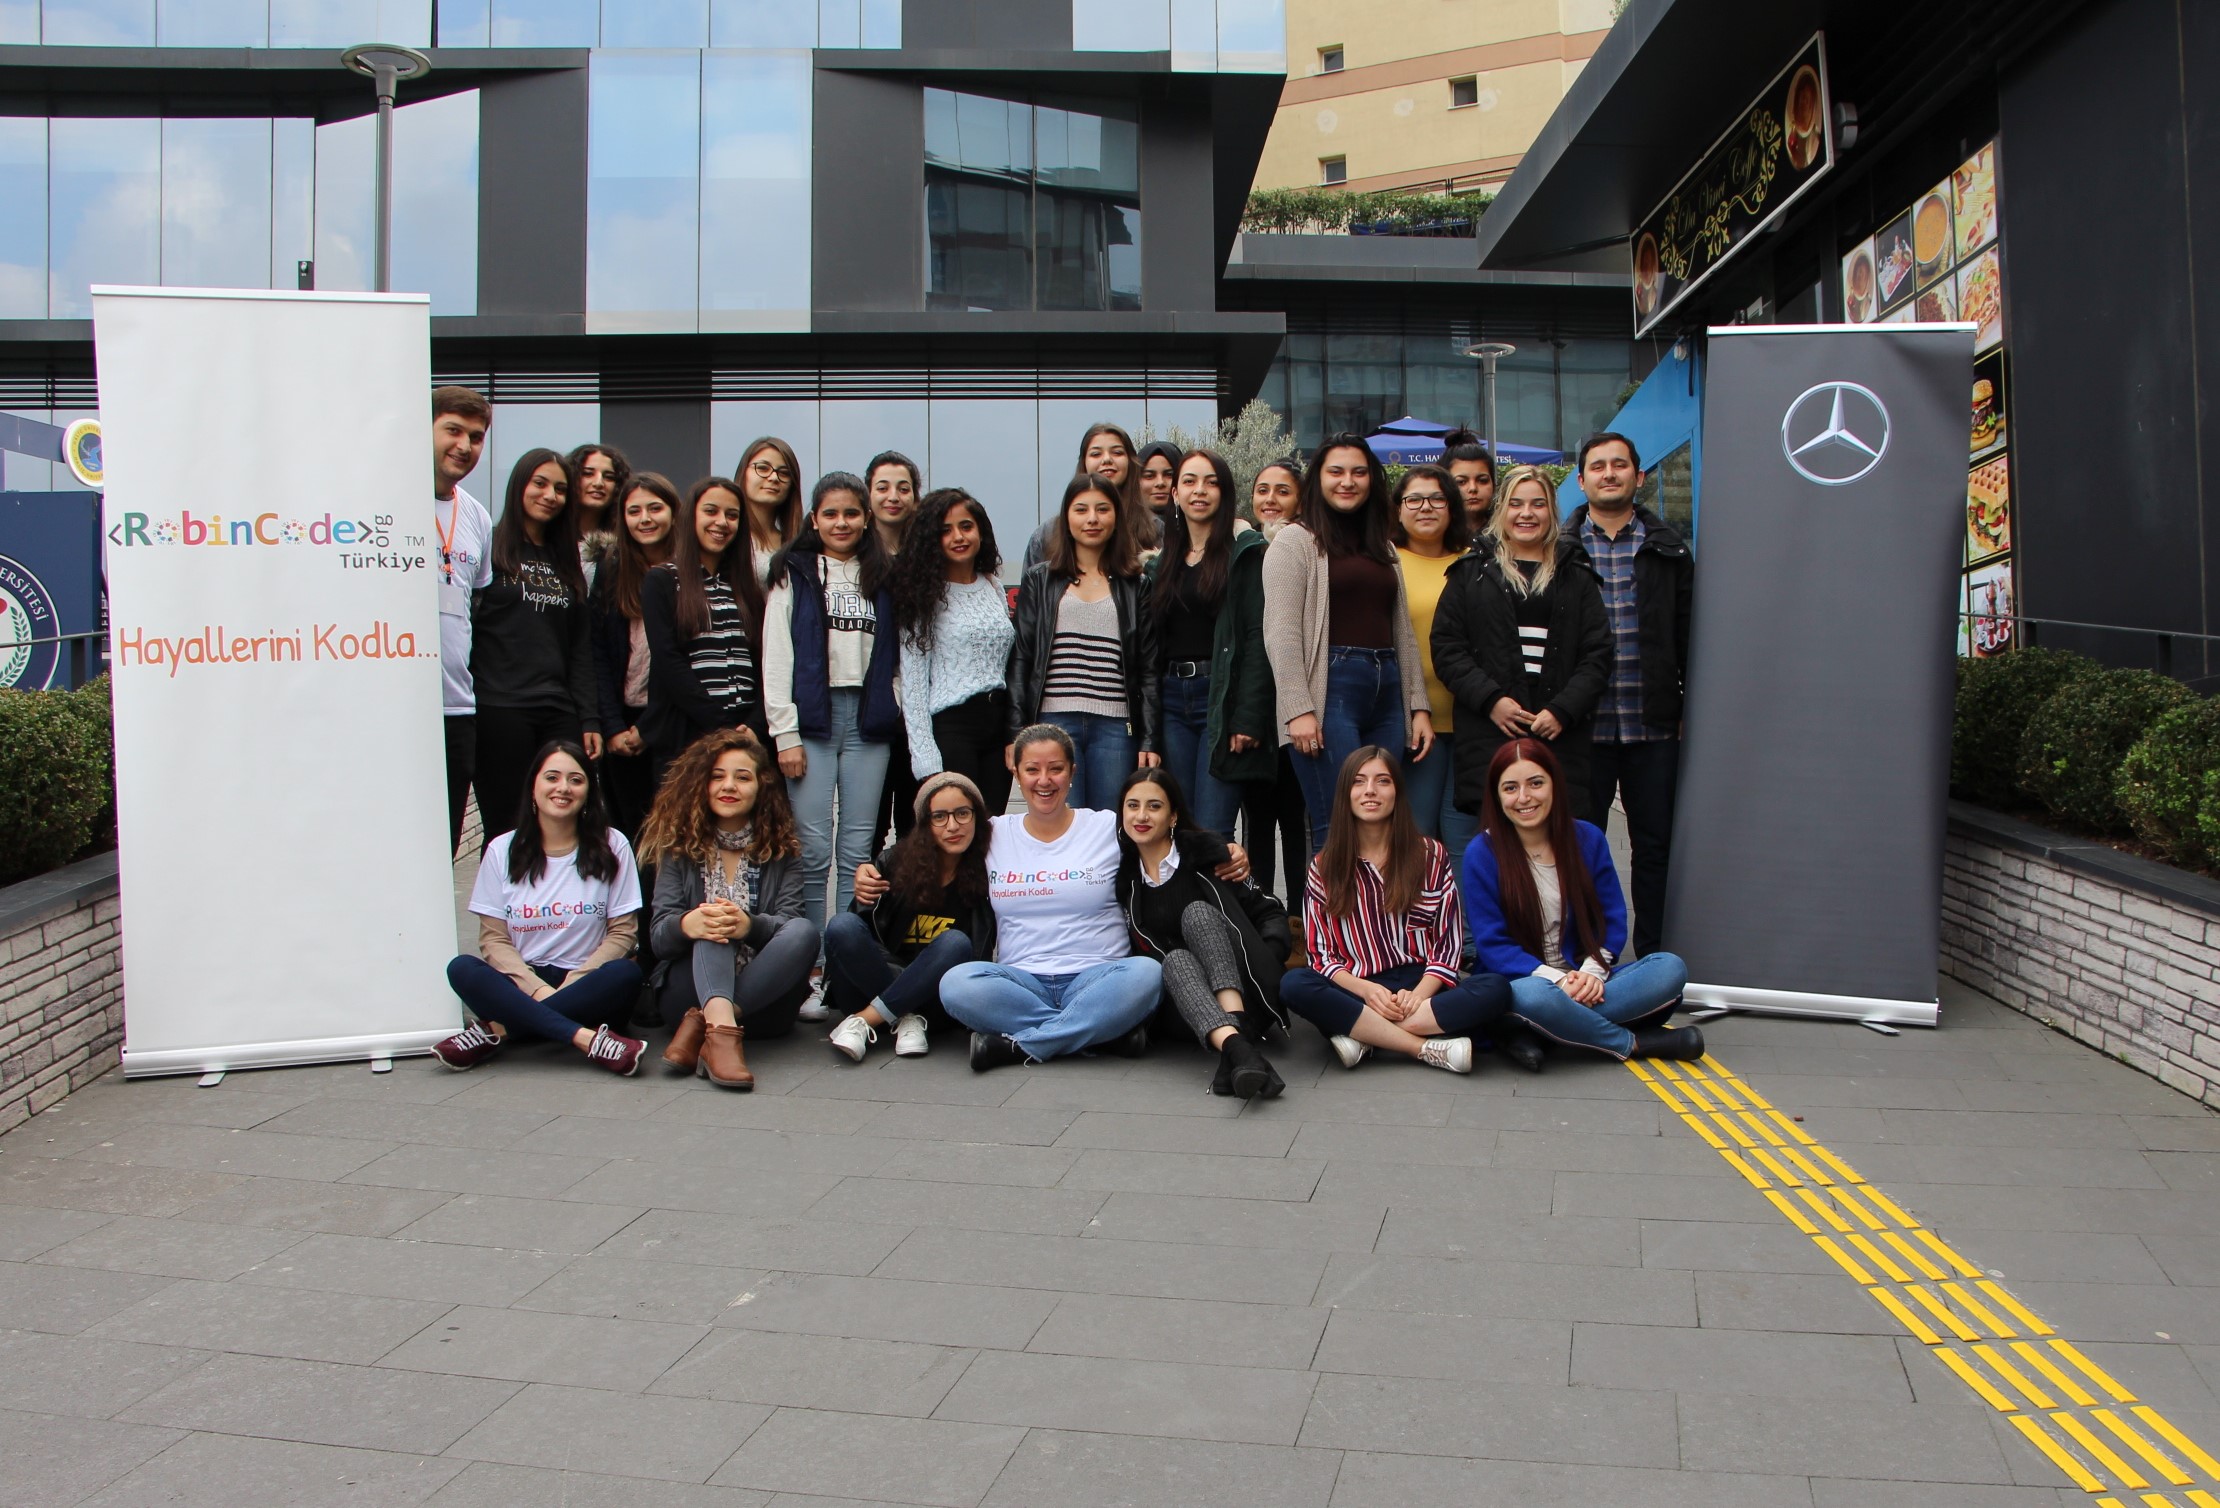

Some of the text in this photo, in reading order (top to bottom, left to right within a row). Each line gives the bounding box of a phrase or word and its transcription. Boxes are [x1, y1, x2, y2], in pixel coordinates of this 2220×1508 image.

[1496, 454, 1512, 463] TESİ
[340, 553, 426, 572] Türkiye
[0, 566, 49, 623] ERSİTESİ
[521, 580, 570, 612] happens
[120, 620, 439, 678] Hayallerini Kodla...
[992, 888, 1027, 900] Hayallerini
